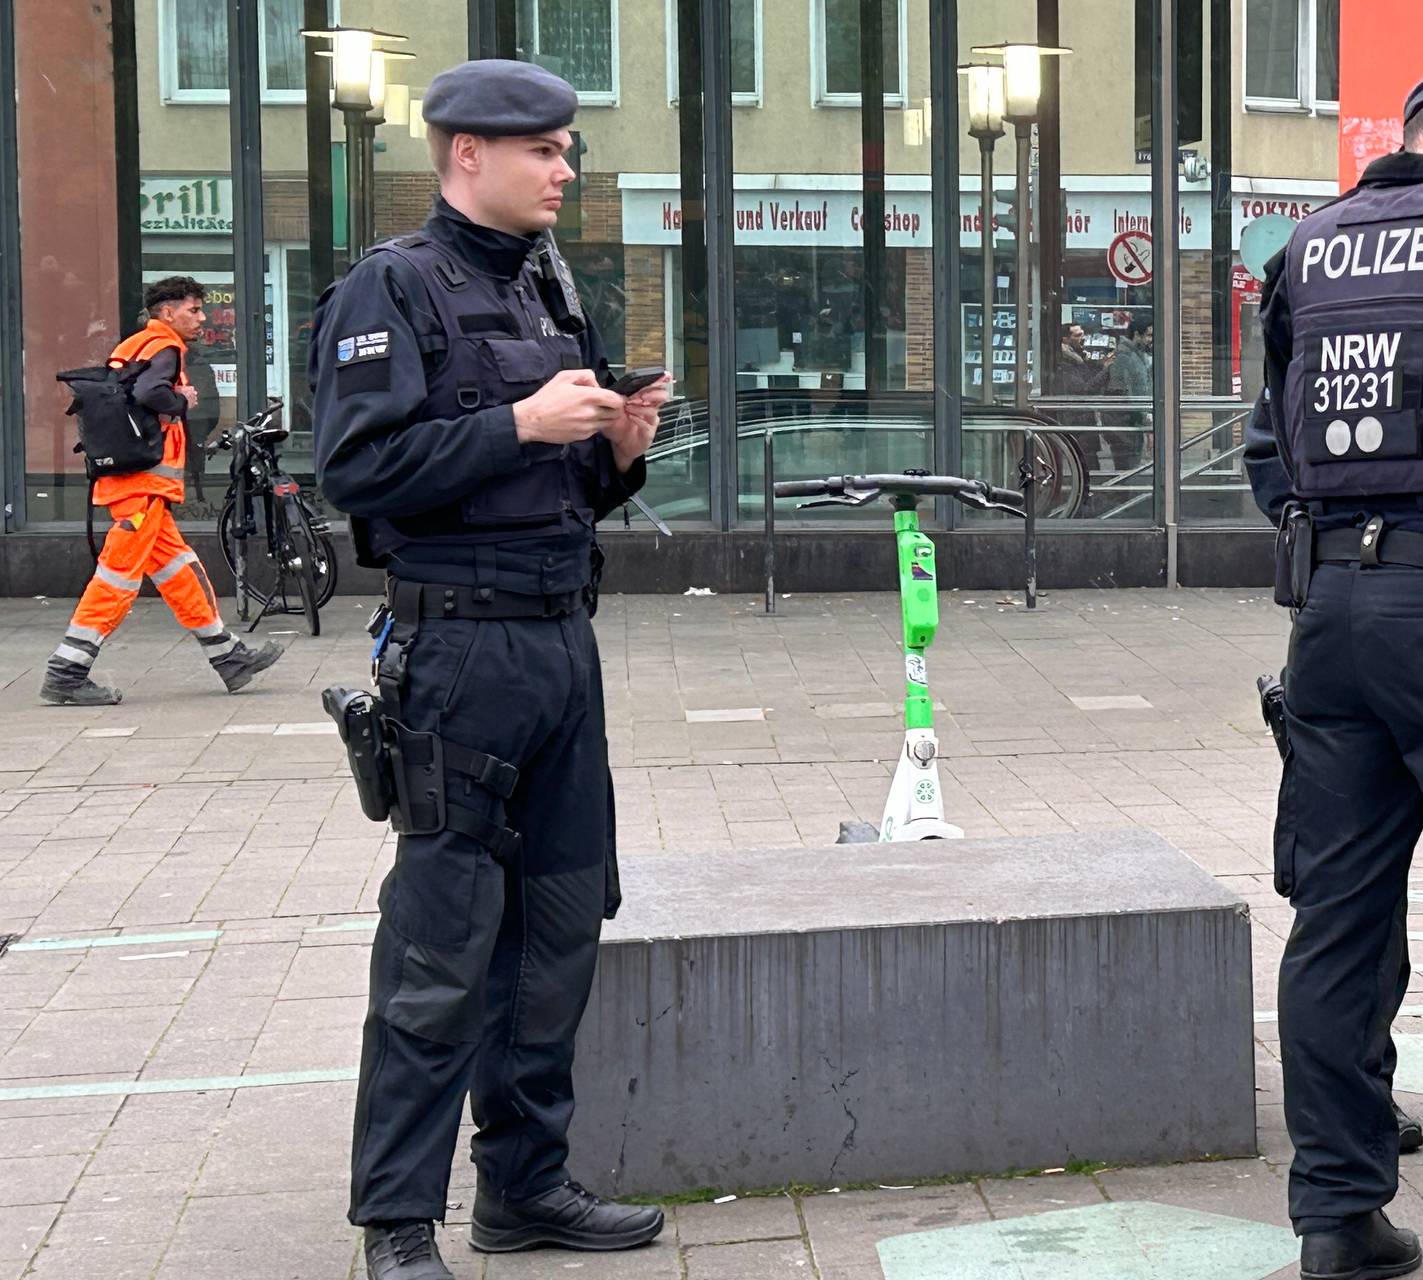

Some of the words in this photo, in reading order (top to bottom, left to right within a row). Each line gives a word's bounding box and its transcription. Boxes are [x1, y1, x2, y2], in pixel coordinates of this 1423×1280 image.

[736, 201, 763, 231] und
[770, 201, 828, 231] Verkauf
[1321, 332, 1402, 372] NRW
[1313, 371, 1394, 413] 31231
